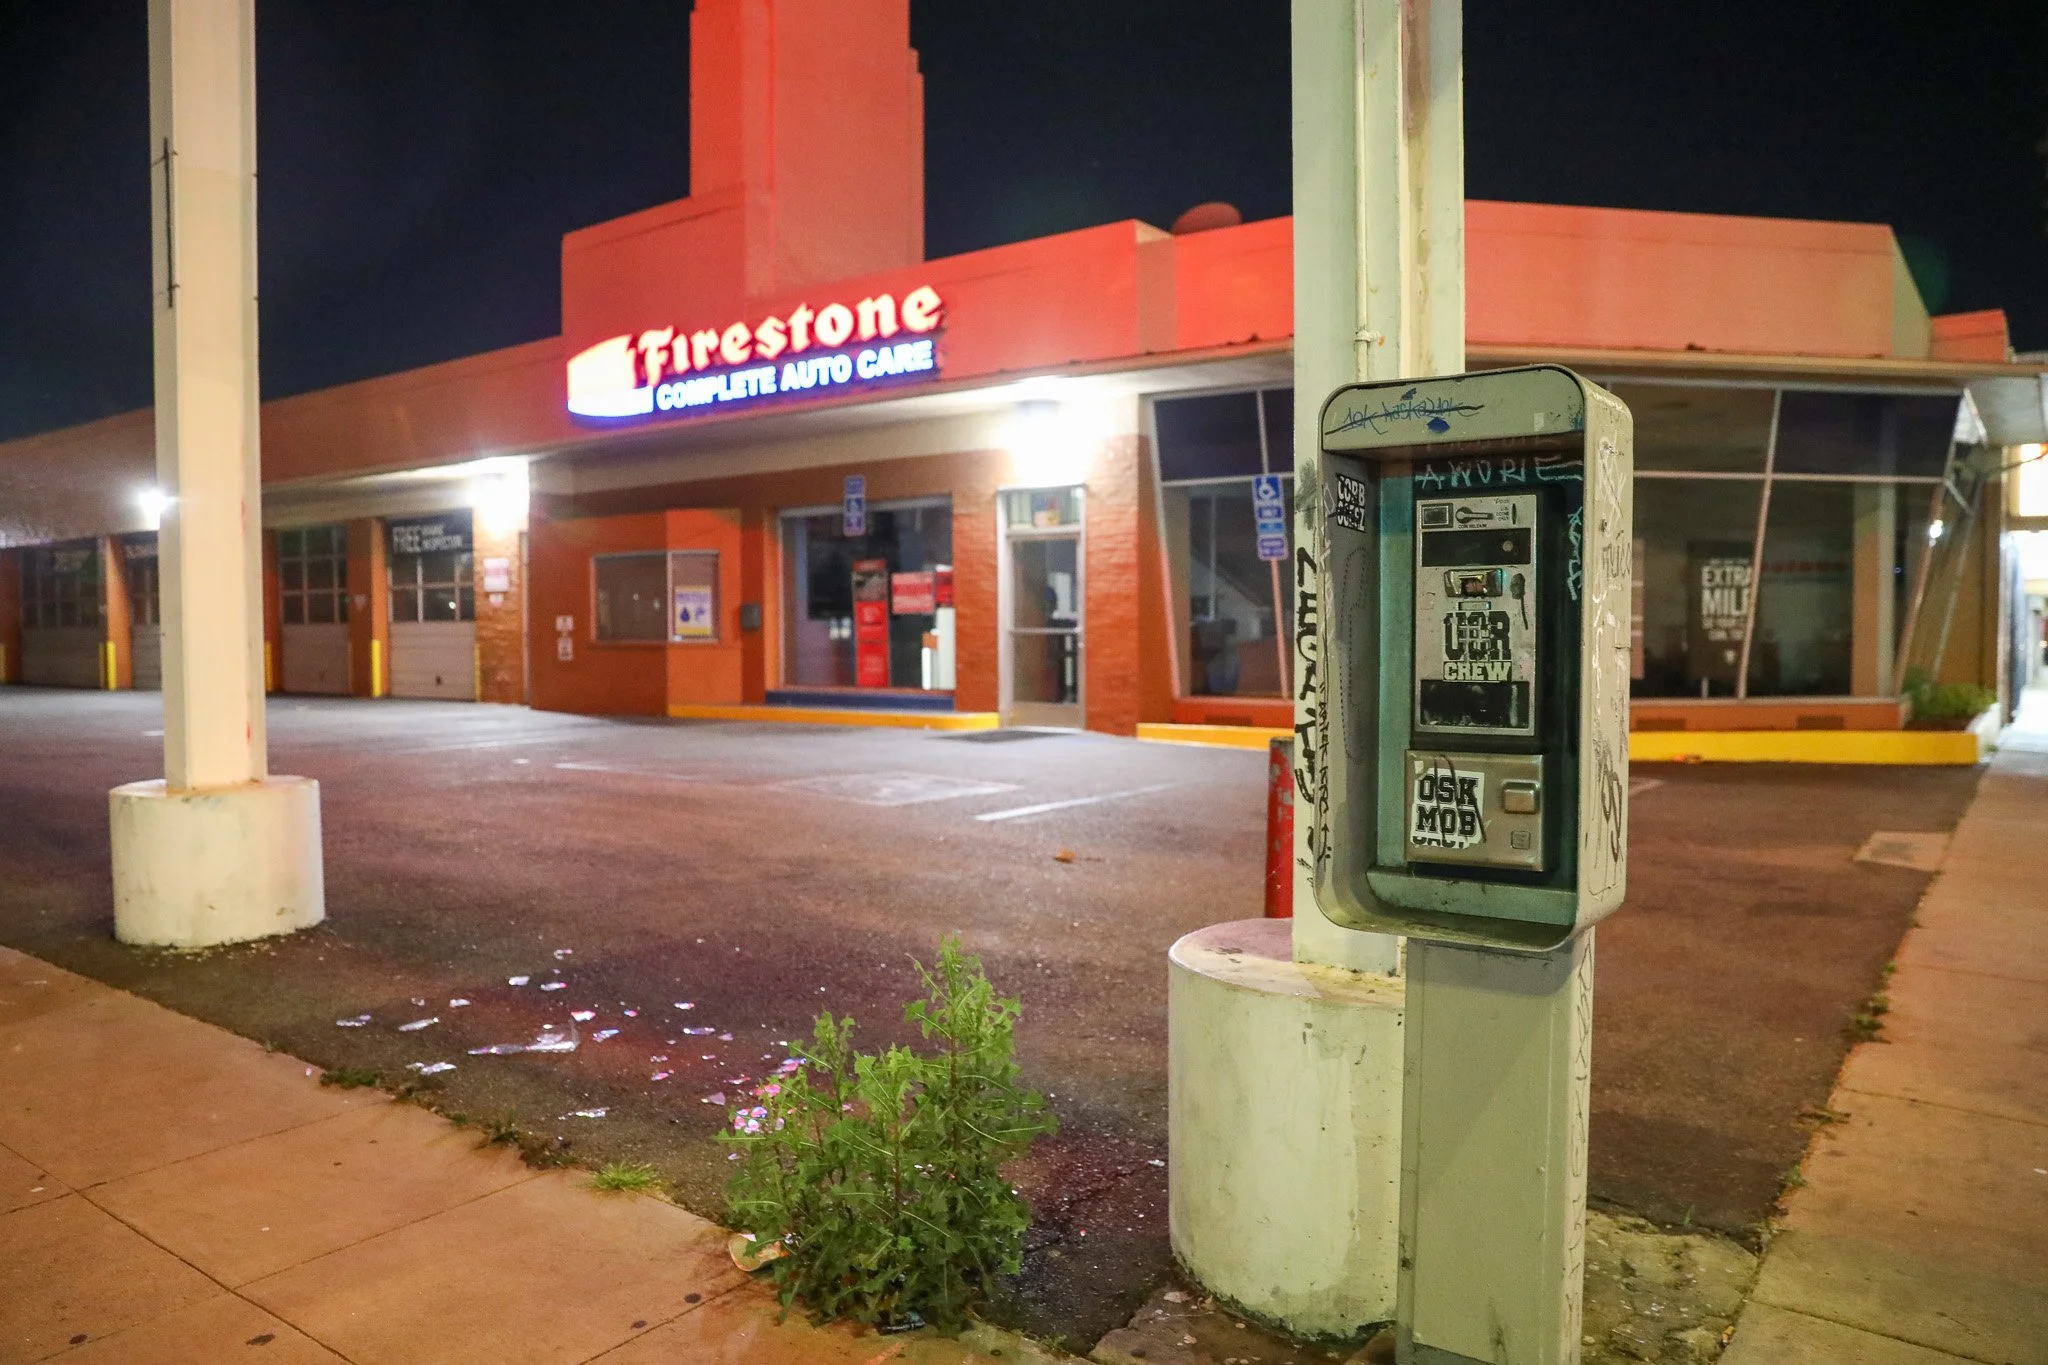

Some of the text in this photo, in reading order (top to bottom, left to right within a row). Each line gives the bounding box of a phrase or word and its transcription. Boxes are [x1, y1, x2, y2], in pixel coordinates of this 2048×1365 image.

[634, 284, 942, 390] Firestone
[655, 339, 933, 411] COMPLETE AUTO CARE
[1443, 660, 1512, 682] CREW
[1418, 774, 1479, 807] OSK
[1415, 803, 1477, 837] MOB
